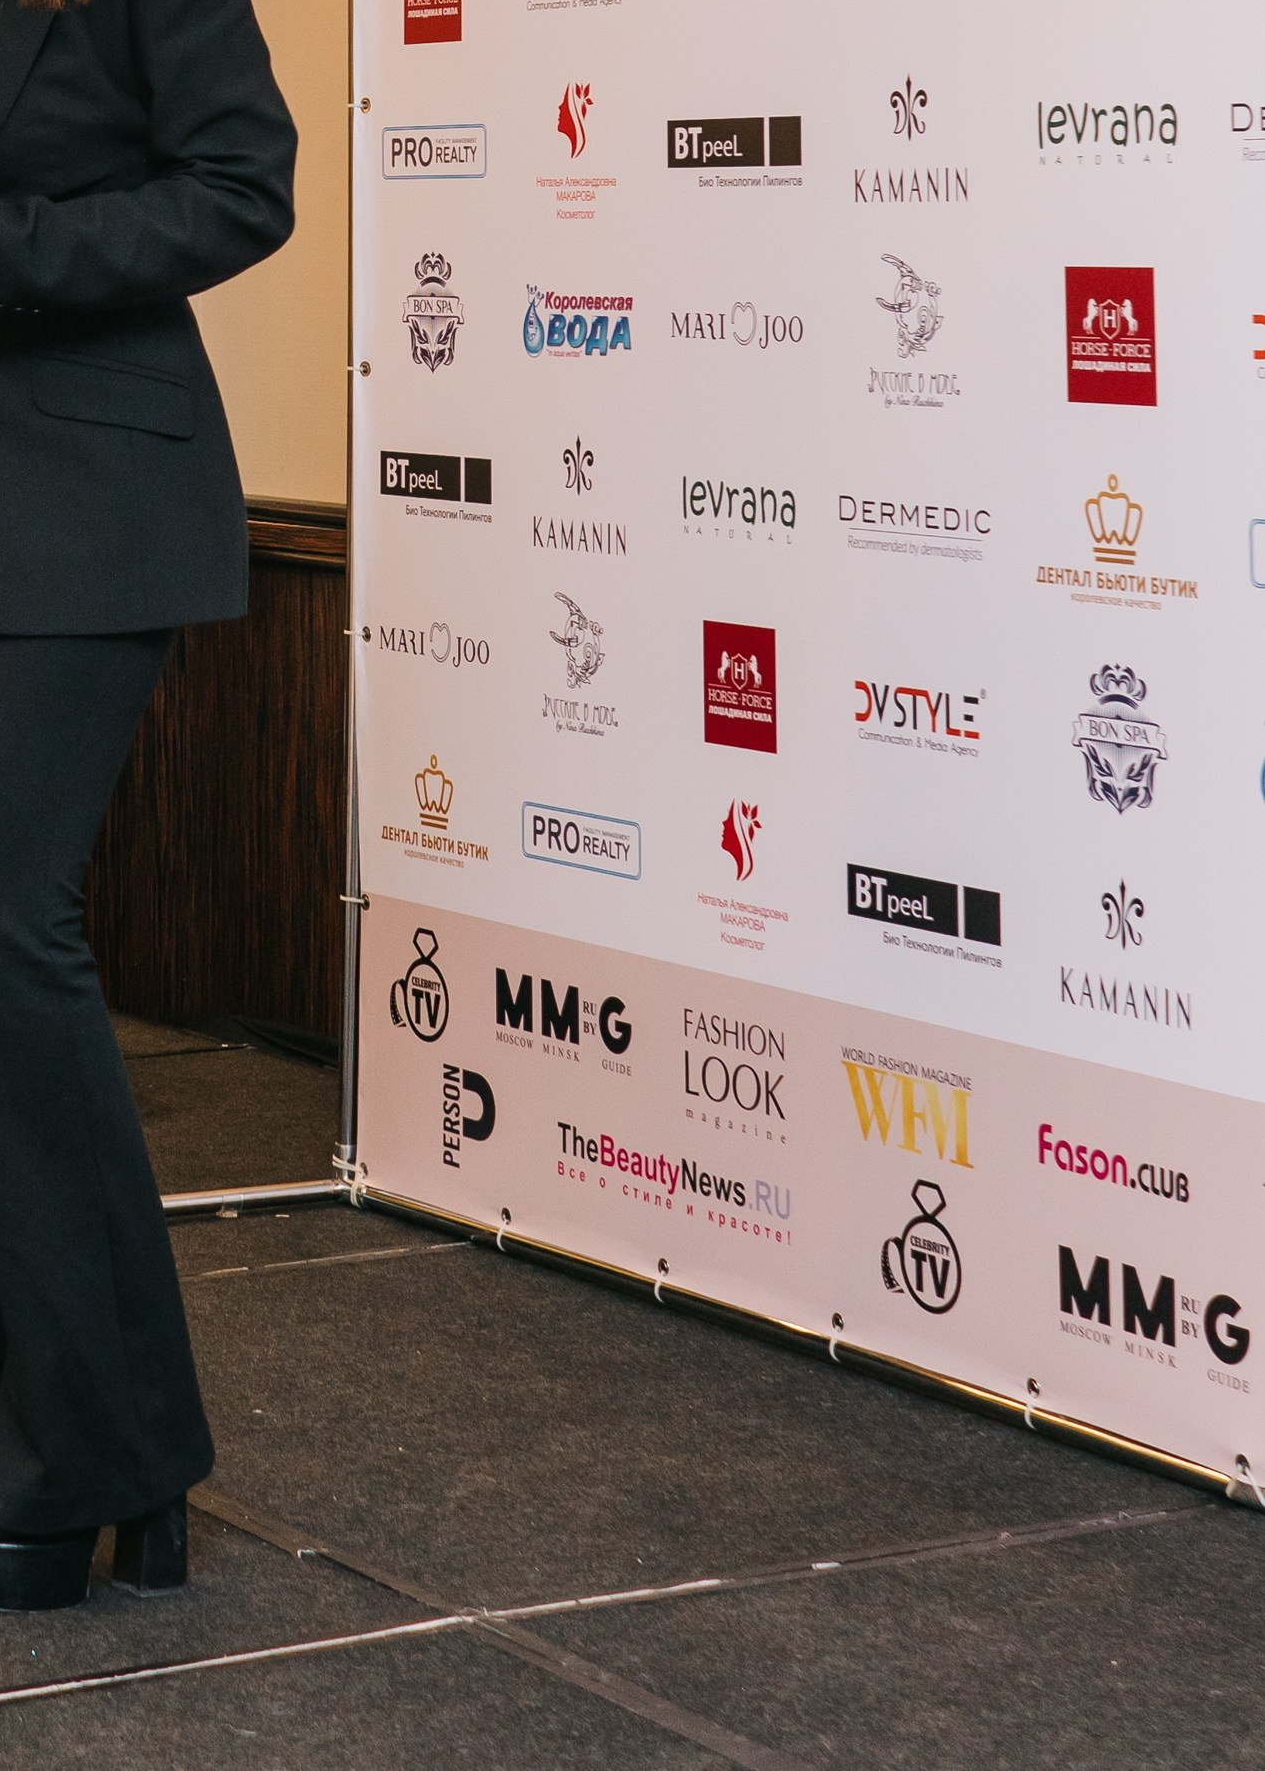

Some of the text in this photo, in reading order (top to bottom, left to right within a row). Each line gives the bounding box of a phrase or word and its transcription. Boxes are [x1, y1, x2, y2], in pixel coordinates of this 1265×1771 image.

[392, 137, 477, 168] PRO REALTY
[557, 191, 596, 201] МАКАРОВА
[699, 176, 803, 187] Био Технологии Пилингов
[854, 167, 969, 203] KAMANIN
[414, 300, 453, 314] BON SPA
[545, 292, 633, 313] Королевская
[547, 314, 631, 356] ВОДА
[671, 312, 803, 349] MARI JOO
[406, 505, 492, 523] Био Технологии Пилингов
[839, 495, 991, 534] DERMEDIC
[533, 516, 626, 556] KAMANIN
[1036, 566, 1198, 599] ДЕНТАЛ БЬЮТИ БУТИК
[379, 626, 490, 668] MARI JOO
[1088, 720, 1150, 744] BON SPA
[382, 826, 489, 861] ДЕНТАЛ БЬЮТИ БУТИК
[533, 815, 630, 862] PRO REALTY
[720, 912, 765, 932] МАКАРОВА
[883, 931, 1002, 969] Био Технологии Пилингов
[412, 976, 441, 991] CELEBRITY
[1060, 965, 1192, 1031] KAMANIN
[412, 988, 441, 1029] TV
[495, 1030, 631, 1076] MOSCOW MINSK GUIDE
[684, 1008, 785, 1061] FASHION
[685, 1050, 786, 1120] LOOK
[841, 1046, 972, 1090] WORLD FASHION MAGAZINE
[443, 1063, 460, 1169] PERSON
[686, 1108, 786, 1144] magazine
[558, 1122, 791, 1220] TheBeautyNews.RU
[1038, 1123, 1190, 1204] Fason.CLUB
[558, 1161, 791, 1246] Все о стиле и красоте!
[910, 1235, 950, 1256] CELEBRITY
[911, 1248, 950, 1299] TV
[1060, 1319, 1250, 1393] MOSCOW MINSK GUIDE
